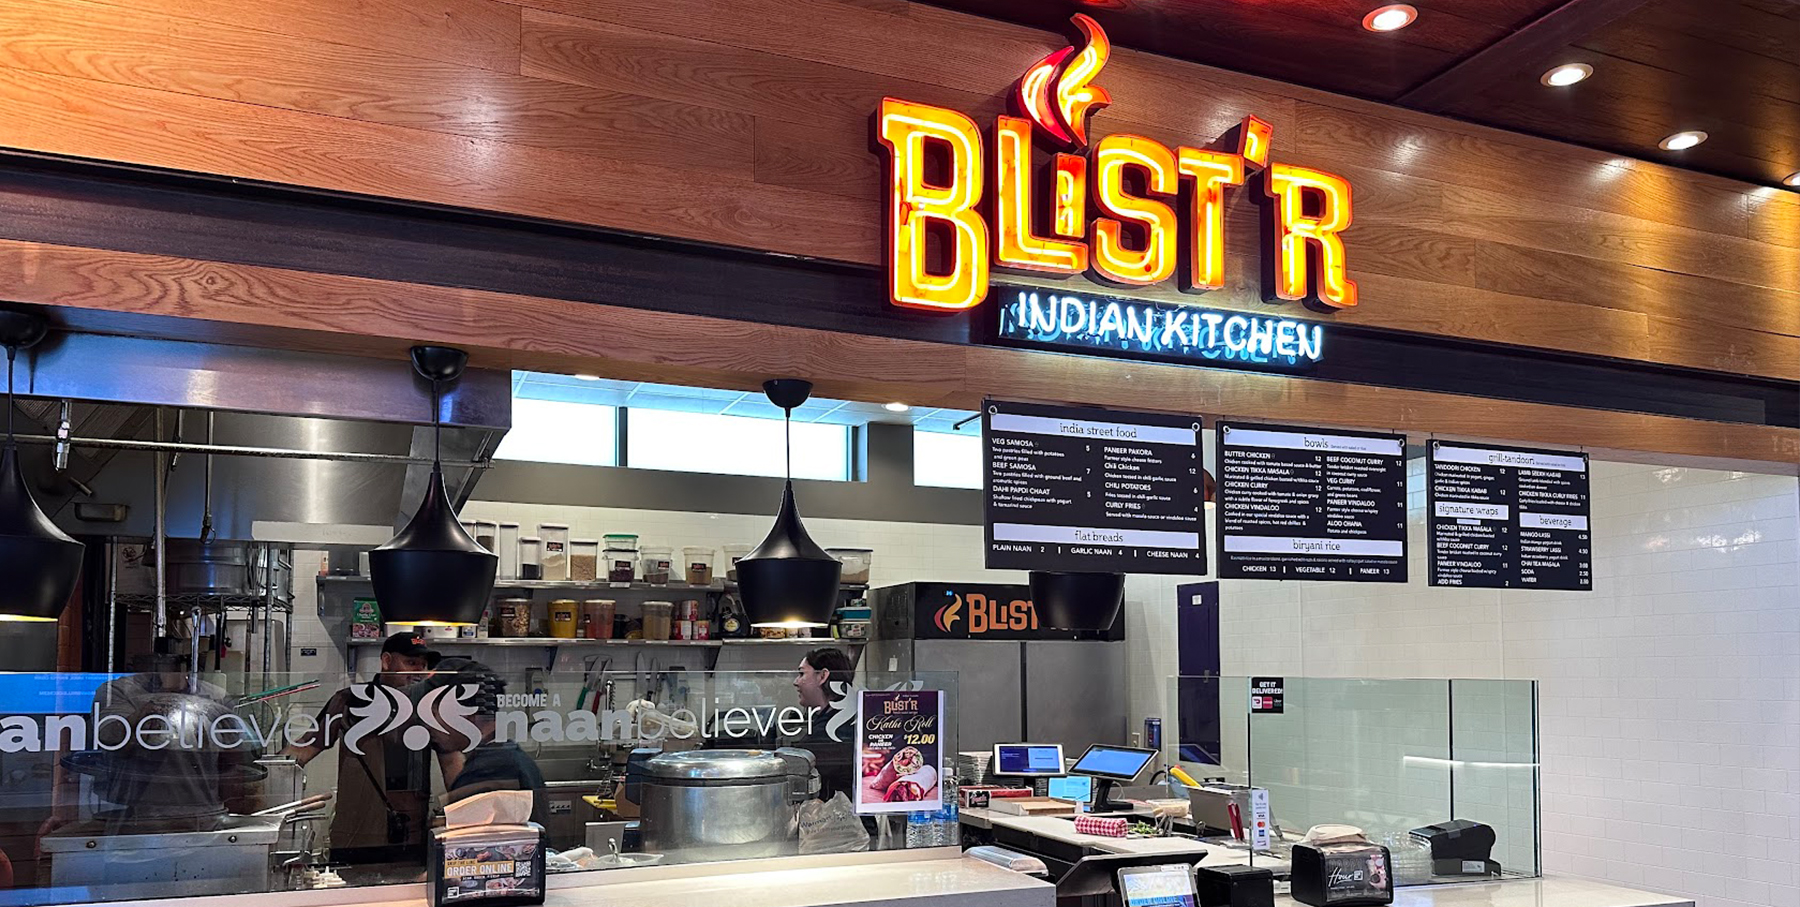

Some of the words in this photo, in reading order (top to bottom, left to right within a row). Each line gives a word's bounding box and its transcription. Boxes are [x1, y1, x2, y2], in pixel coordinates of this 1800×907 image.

[877, 95, 1359, 312] BLIST'R
[1017, 292, 1153, 342] INDIAN
[1162, 310, 1323, 359] KITCHEN
[1060, 423, 1084, 434] india
[1087, 427, 1113, 437] street
[1116, 428, 1137, 438] food
[1304, 437, 1328, 448] bowls
[1439, 504, 1473, 515] signature
[1476, 507, 1498, 516] wraps
[1539, 515, 1572, 528] beverage
[1075, 531, 1091, 541] flat
[1093, 531, 1123, 542] breads
[1071, 547, 1093, 555] GARLIC
[1094, 548, 1112, 556] NAAN
[1293, 539, 1323, 552] biryani
[1325, 541, 1341, 551] rice
[1147, 550, 1169, 558] CHEESE
[966, 594, 1038, 633] BLIST
[497, 693, 548, 708] BECOME
[552, 693, 561, 707] A
[884, 698, 918, 714] BLIST'R
[866, 715, 902, 731] Kathi
[904, 715, 937, 734] Roll
[904, 734, 935, 745] $12.00
[447, 866, 477, 876] ORDER
[480, 863, 512, 874] ONLINE
[1328, 867, 1354, 887] Hour
